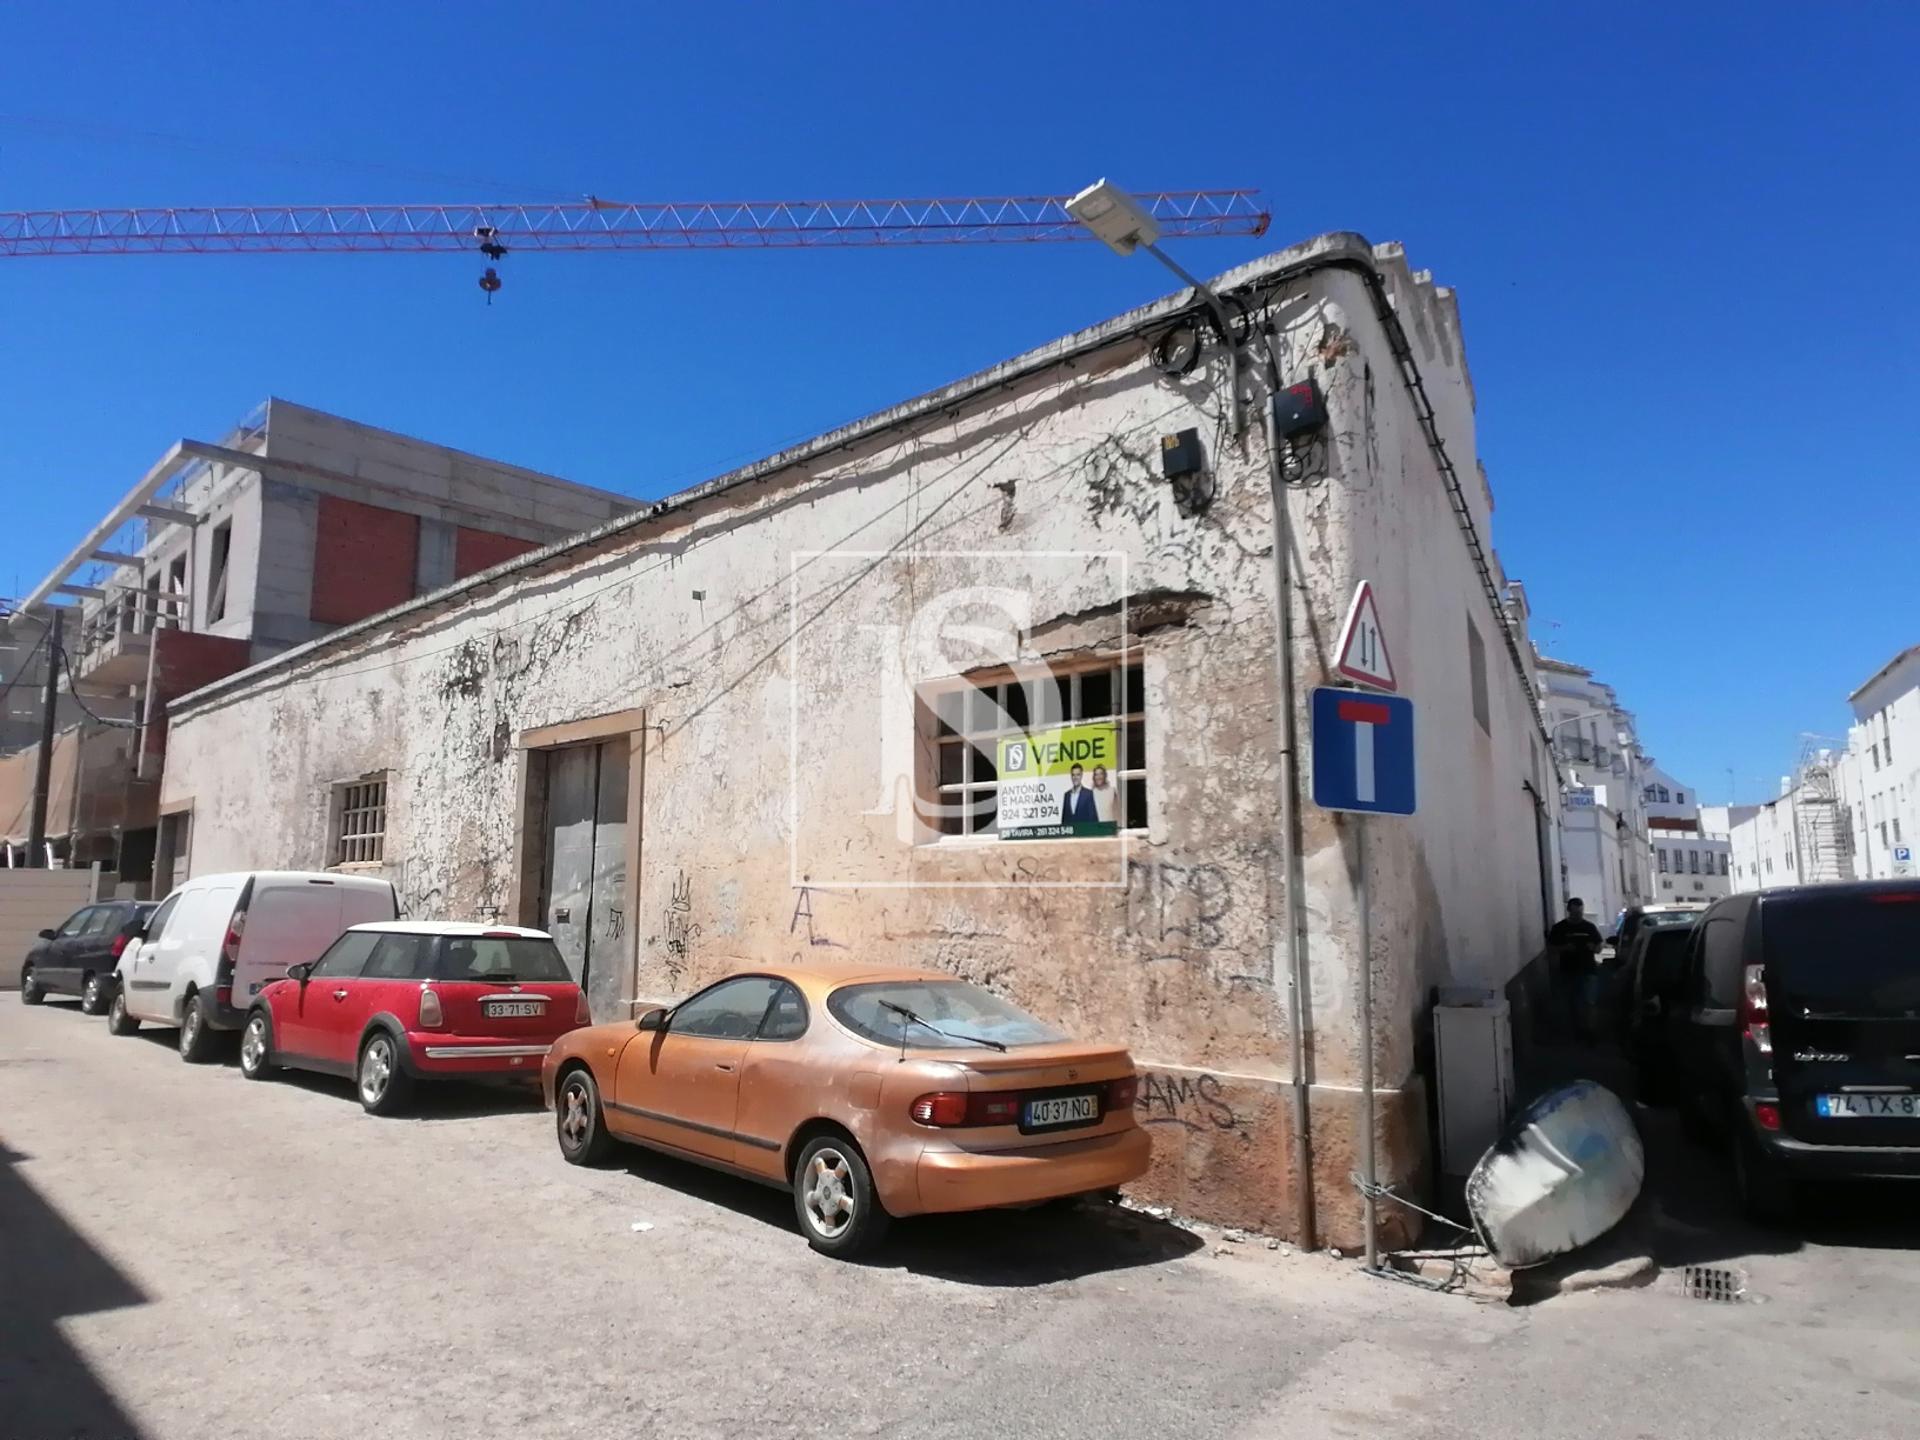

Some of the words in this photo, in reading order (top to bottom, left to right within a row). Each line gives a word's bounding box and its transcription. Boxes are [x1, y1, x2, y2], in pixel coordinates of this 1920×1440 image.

[1032, 737, 1105, 765] VENDE
[1002, 797, 1008, 807] E
[1010, 793, 1055, 805] MARIANA
[1002, 808, 1020, 820] 924
[1023, 807, 1039, 819] 321
[1041, 806, 1060, 818] 974
